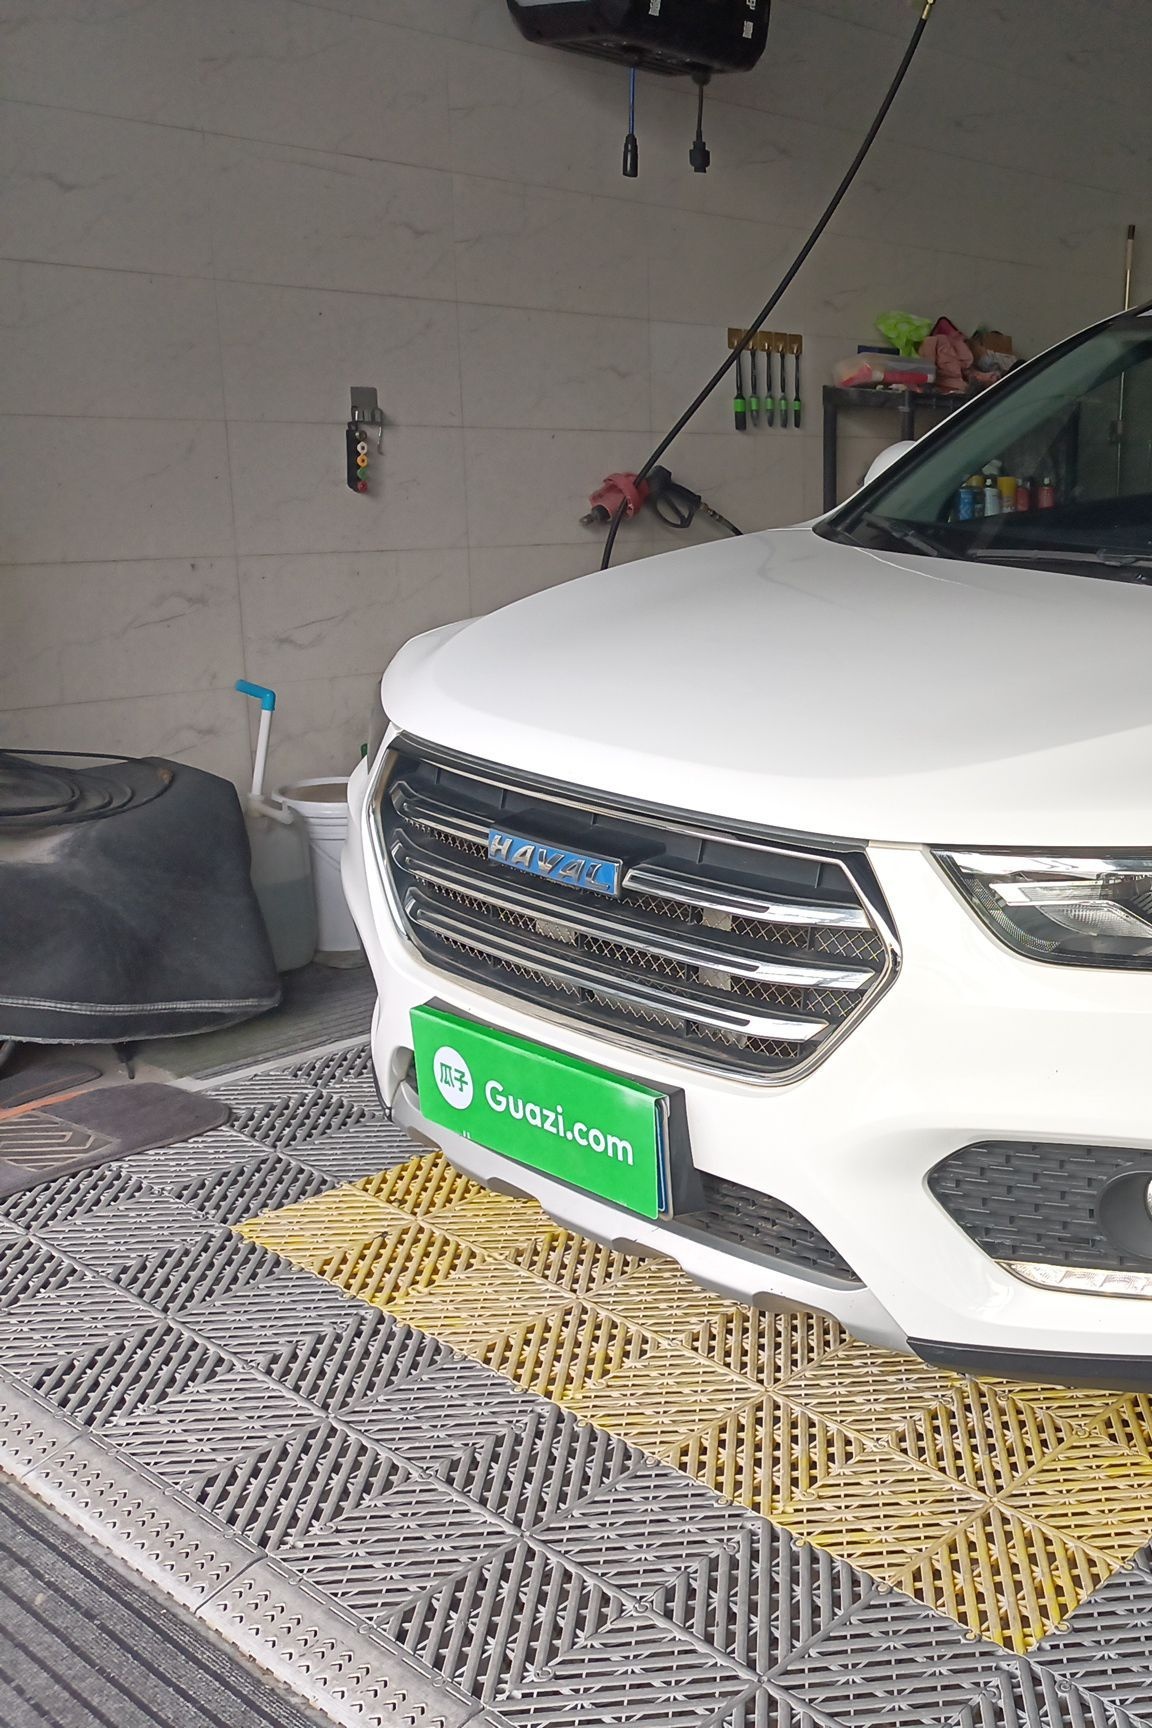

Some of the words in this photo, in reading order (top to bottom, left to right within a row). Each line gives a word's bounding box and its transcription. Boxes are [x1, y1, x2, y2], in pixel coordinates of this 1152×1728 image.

[490, 834, 611, 891] HAVAL
[439, 1062, 469, 1093] 瓜子
[484, 1080, 634, 1166] Guazi.com
